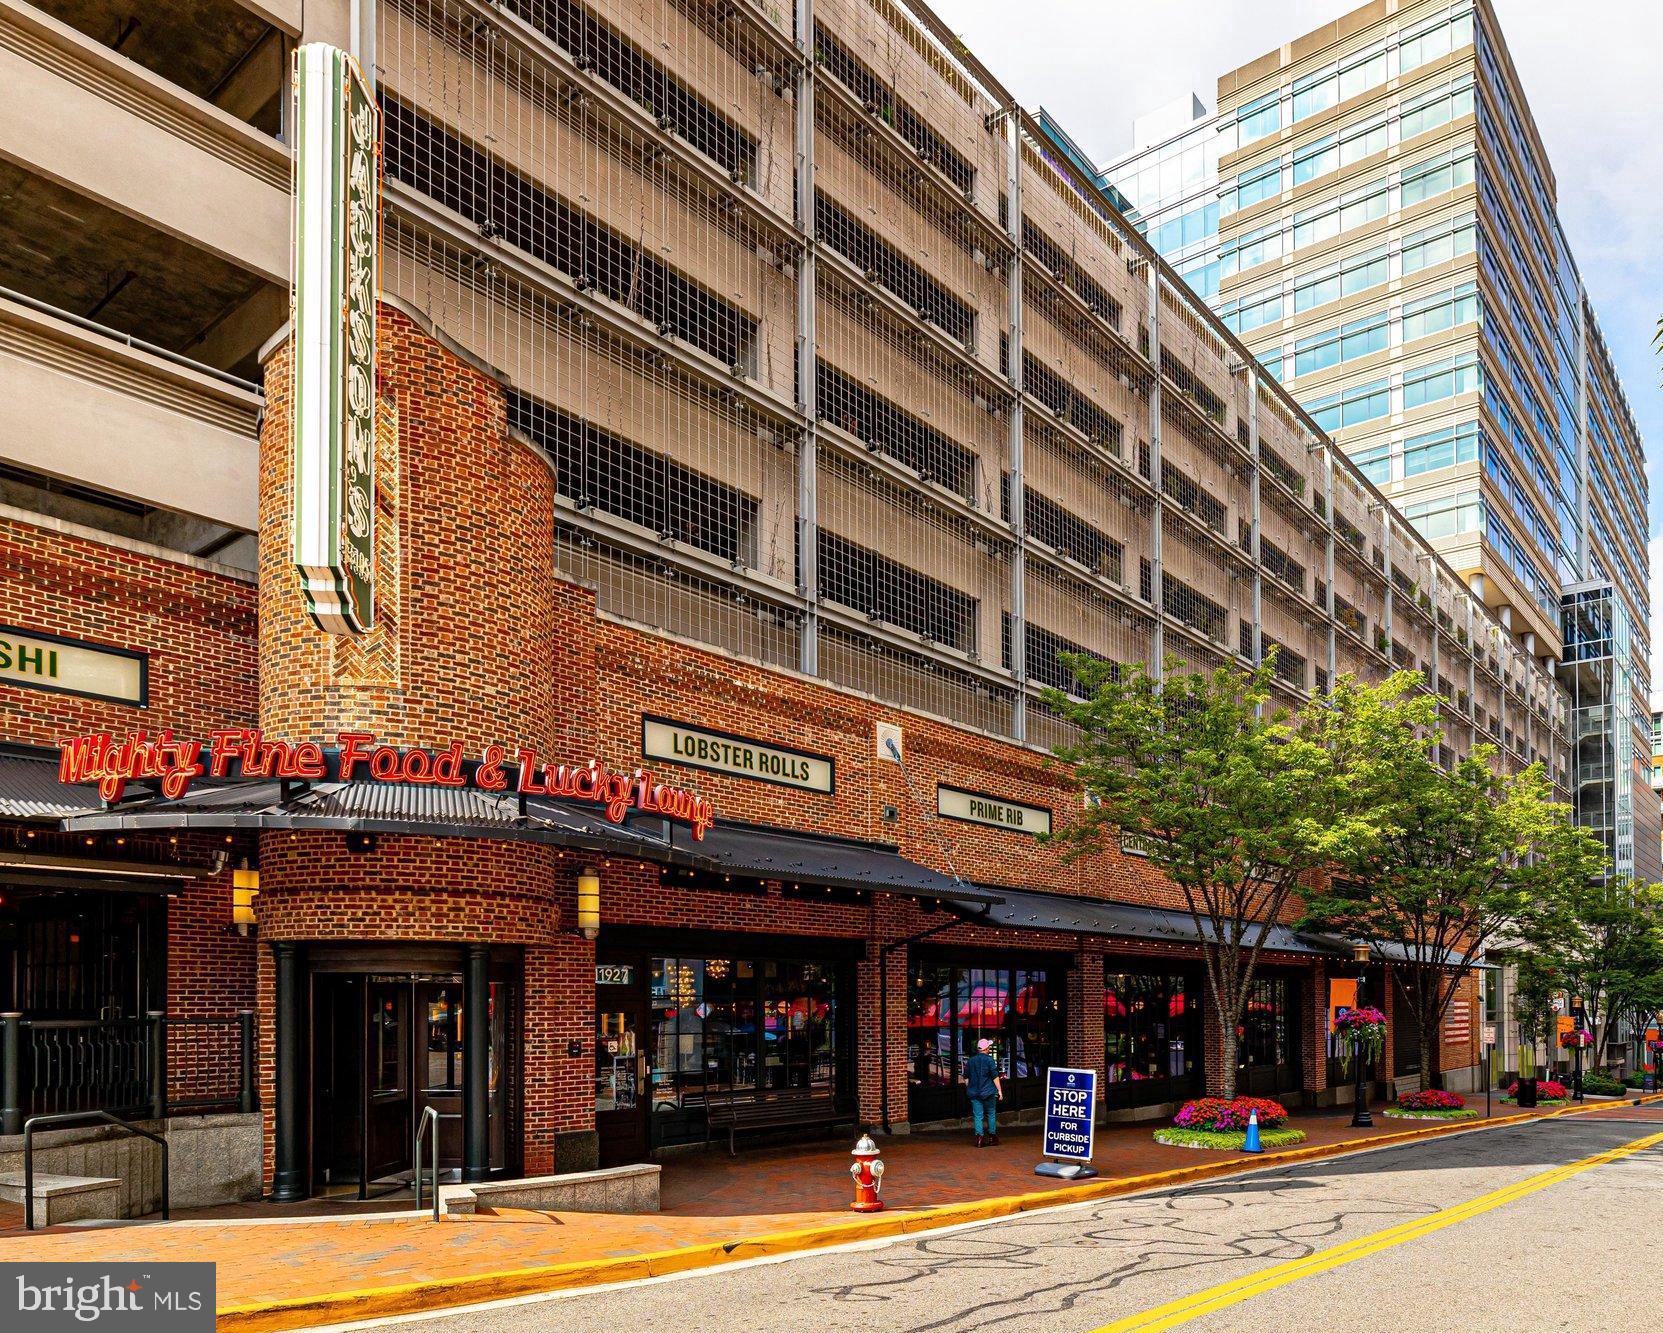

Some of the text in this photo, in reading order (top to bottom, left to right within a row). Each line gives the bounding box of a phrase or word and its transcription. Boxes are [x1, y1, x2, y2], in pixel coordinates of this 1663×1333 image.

[673, 732, 810, 781] LOBSTER ROLLS
[58, 728, 714, 842] Mighty Fine Food & Lucky Lounge
[970, 800, 1024, 826] PRIME RIB
[1053, 1090, 1088, 1103] STOP
[1052, 1104, 1087, 1118] HERE
[1060, 1121, 1077, 1131] FOR
[1047, 1131, 1090, 1144] CURBSIDE
[1053, 1143, 1085, 1154] PICKUP
